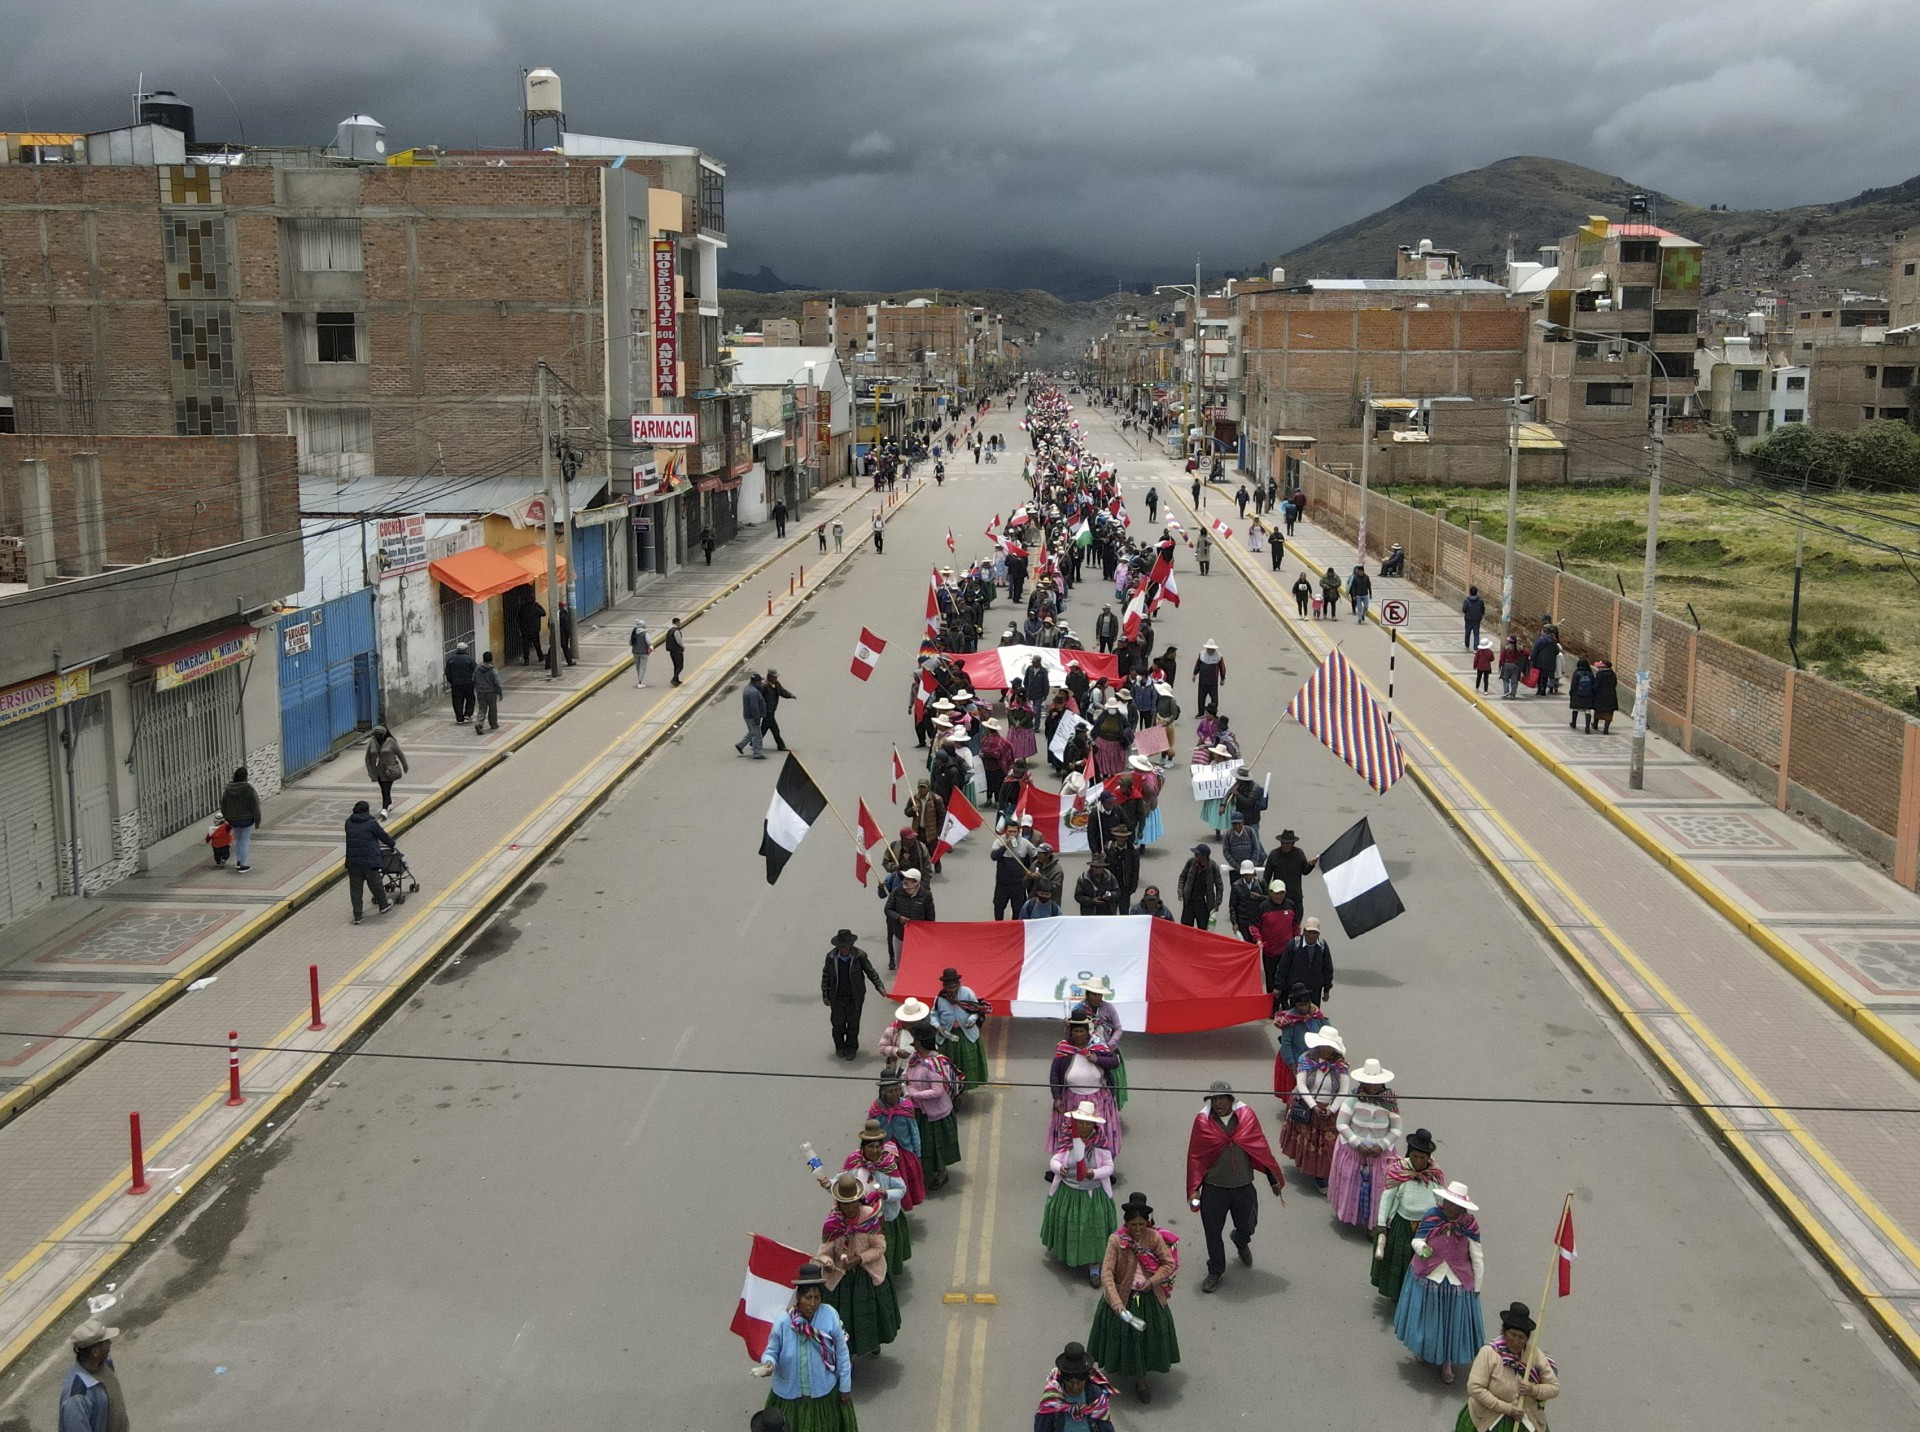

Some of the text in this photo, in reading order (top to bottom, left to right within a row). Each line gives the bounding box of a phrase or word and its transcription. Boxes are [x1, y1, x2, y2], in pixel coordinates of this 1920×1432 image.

[656, 252, 672, 326] HOSPEDAJE
[658, 343, 673, 390] ANDINA
[634, 420, 693, 438] FARMACIA
[380, 519, 405, 537] COCHERA
[1389, 605, 1400, 620] E
[174, 649, 214, 674] COMERCIAL
[182, 663, 213, 681] ABARROTES
[222, 652, 246, 666] GENERAL
